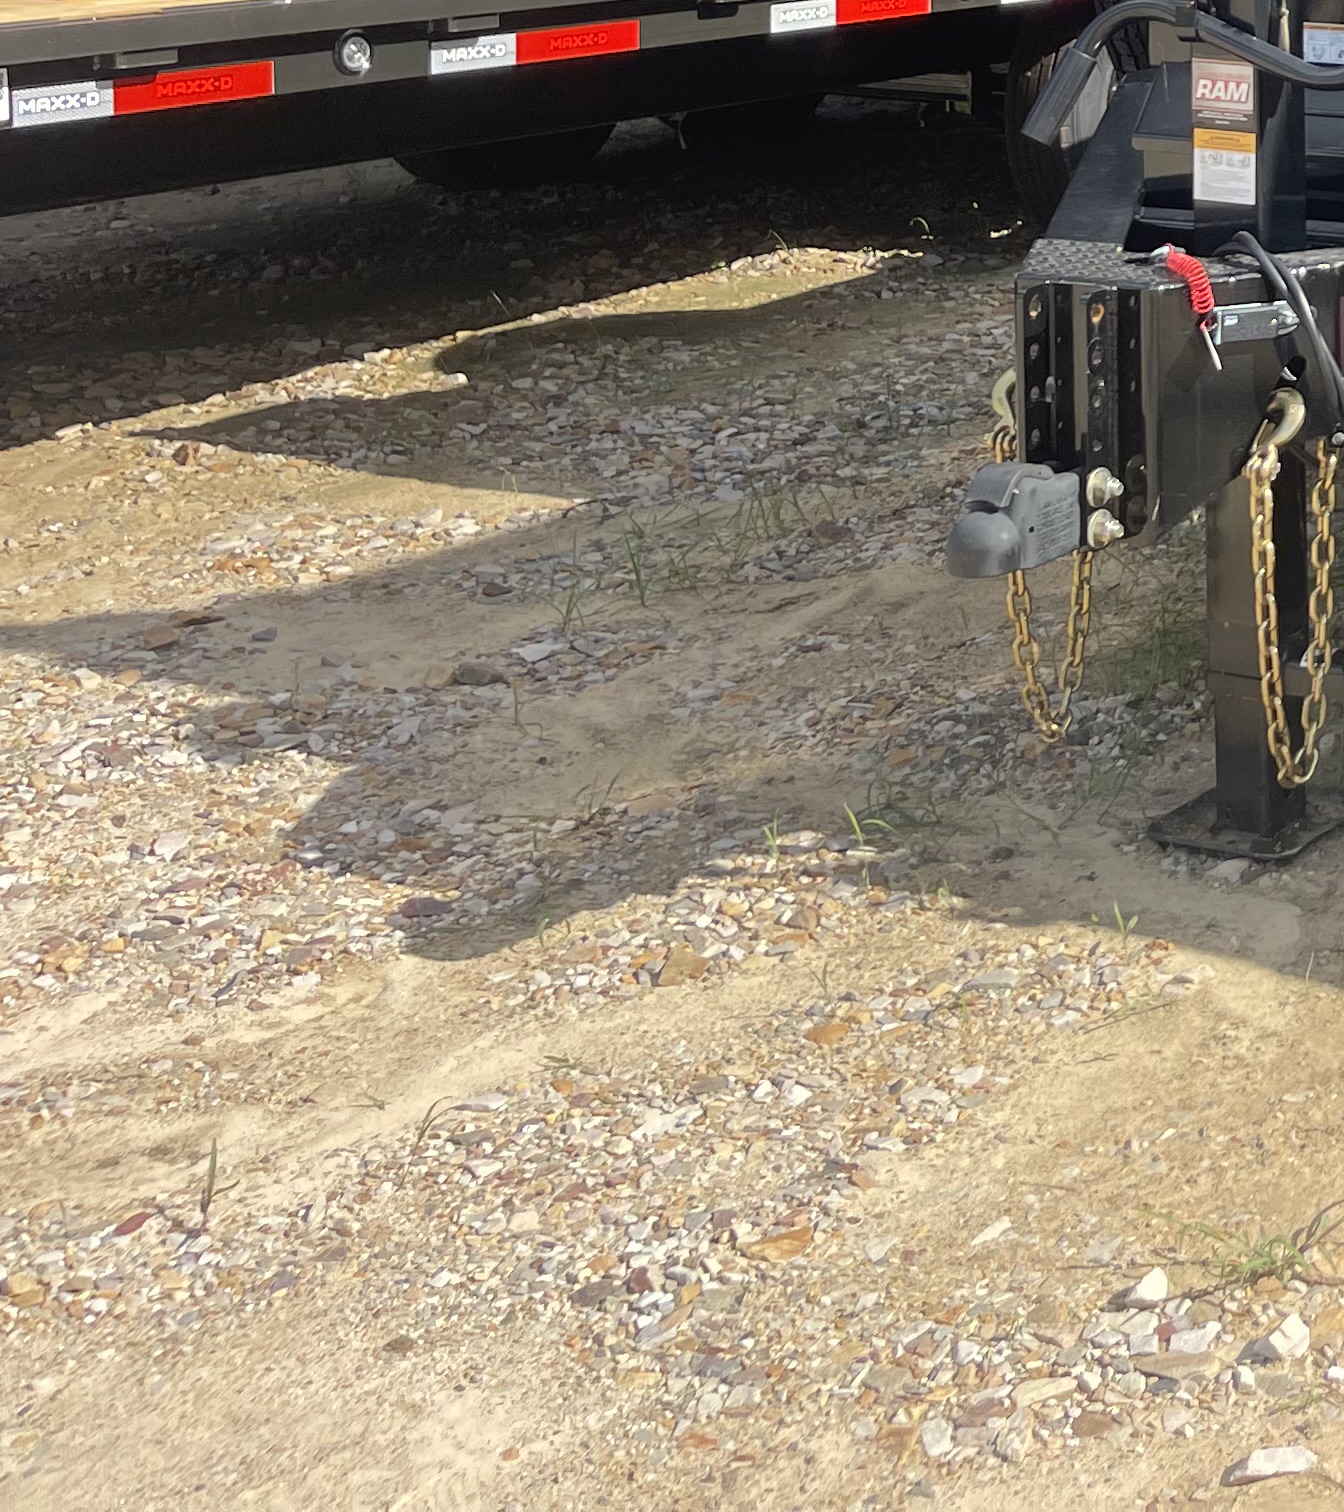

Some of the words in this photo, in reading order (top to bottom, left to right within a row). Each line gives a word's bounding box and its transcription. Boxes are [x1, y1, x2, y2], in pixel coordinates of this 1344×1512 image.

[779, 6, 828, 23] MAXX-D
[549, 33, 608, 50] MAXX-D
[442, 44, 505, 62] MAXX-D
[156, 77, 233, 98] MAXX-D
[1196, 78, 1249, 102] RAM
[18, 92, 100, 114] MAXX-D
